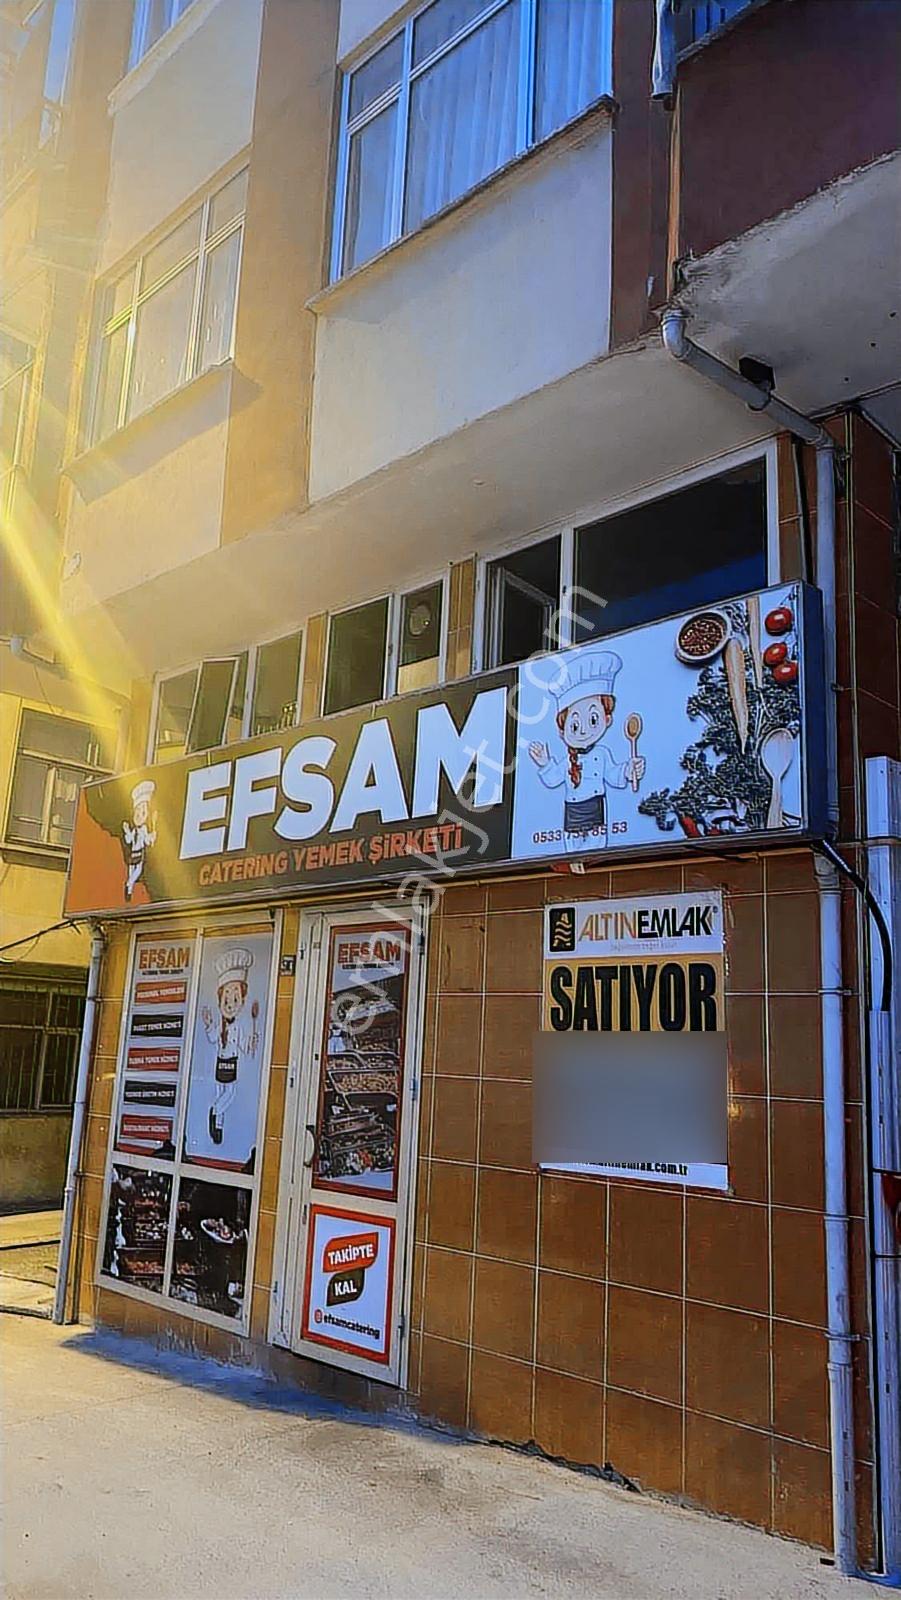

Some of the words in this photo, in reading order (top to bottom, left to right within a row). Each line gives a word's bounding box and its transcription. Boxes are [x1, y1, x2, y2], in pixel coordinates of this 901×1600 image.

[179, 686, 508, 860] EFSAM
[532, 829, 563, 844] 0533
[611, 821, 628, 834] 53
[292, 837, 365, 872] YEMEK
[368, 821, 463, 865] ŞİRKETİ
[139, 947, 191, 970] EFSAM
[338, 940, 401, 964] EFSAM
[550, 962, 717, 1032] SATIYOR
[327, 1244, 375, 1265] TAKİPTE
[334, 1280, 358, 1297] KAL
[323, 1313, 381, 1340] efsamcatering
